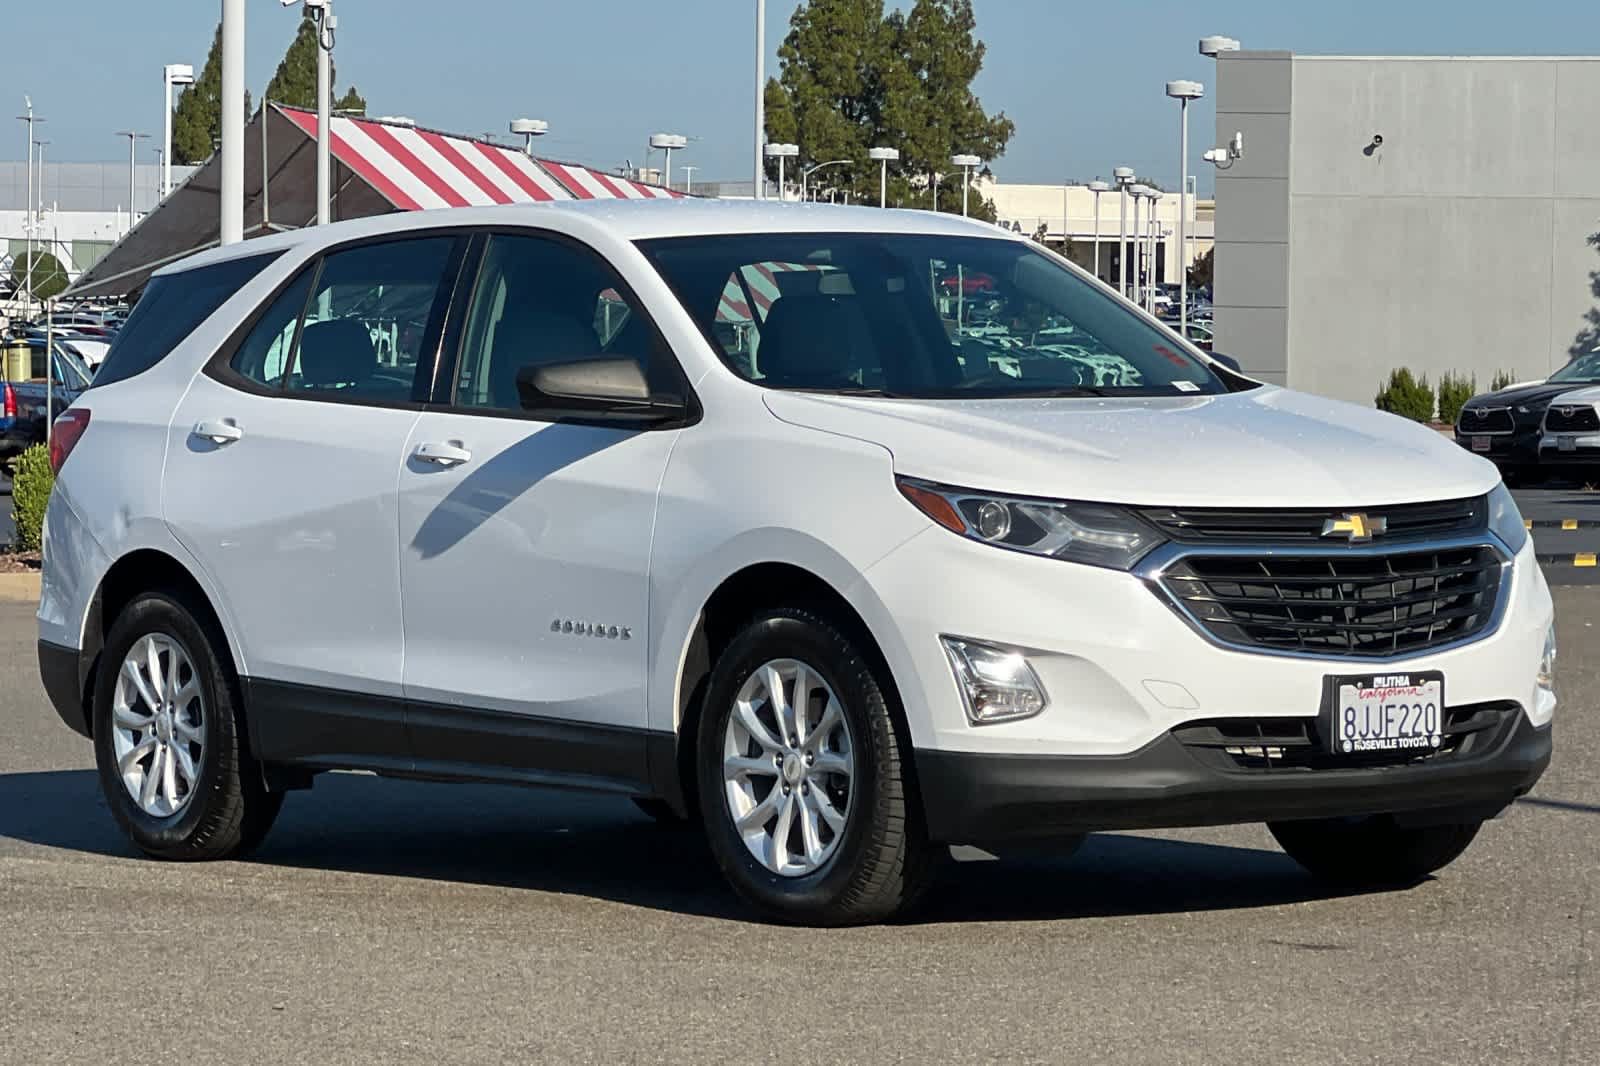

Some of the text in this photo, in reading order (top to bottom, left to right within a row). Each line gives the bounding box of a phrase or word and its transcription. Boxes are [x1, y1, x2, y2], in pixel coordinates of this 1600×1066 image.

[1359, 687, 1424, 703] California
[1344, 703, 1436, 739] 8JJF220
[1354, 737, 1429, 751] ROSEVILLE TOYOTA
